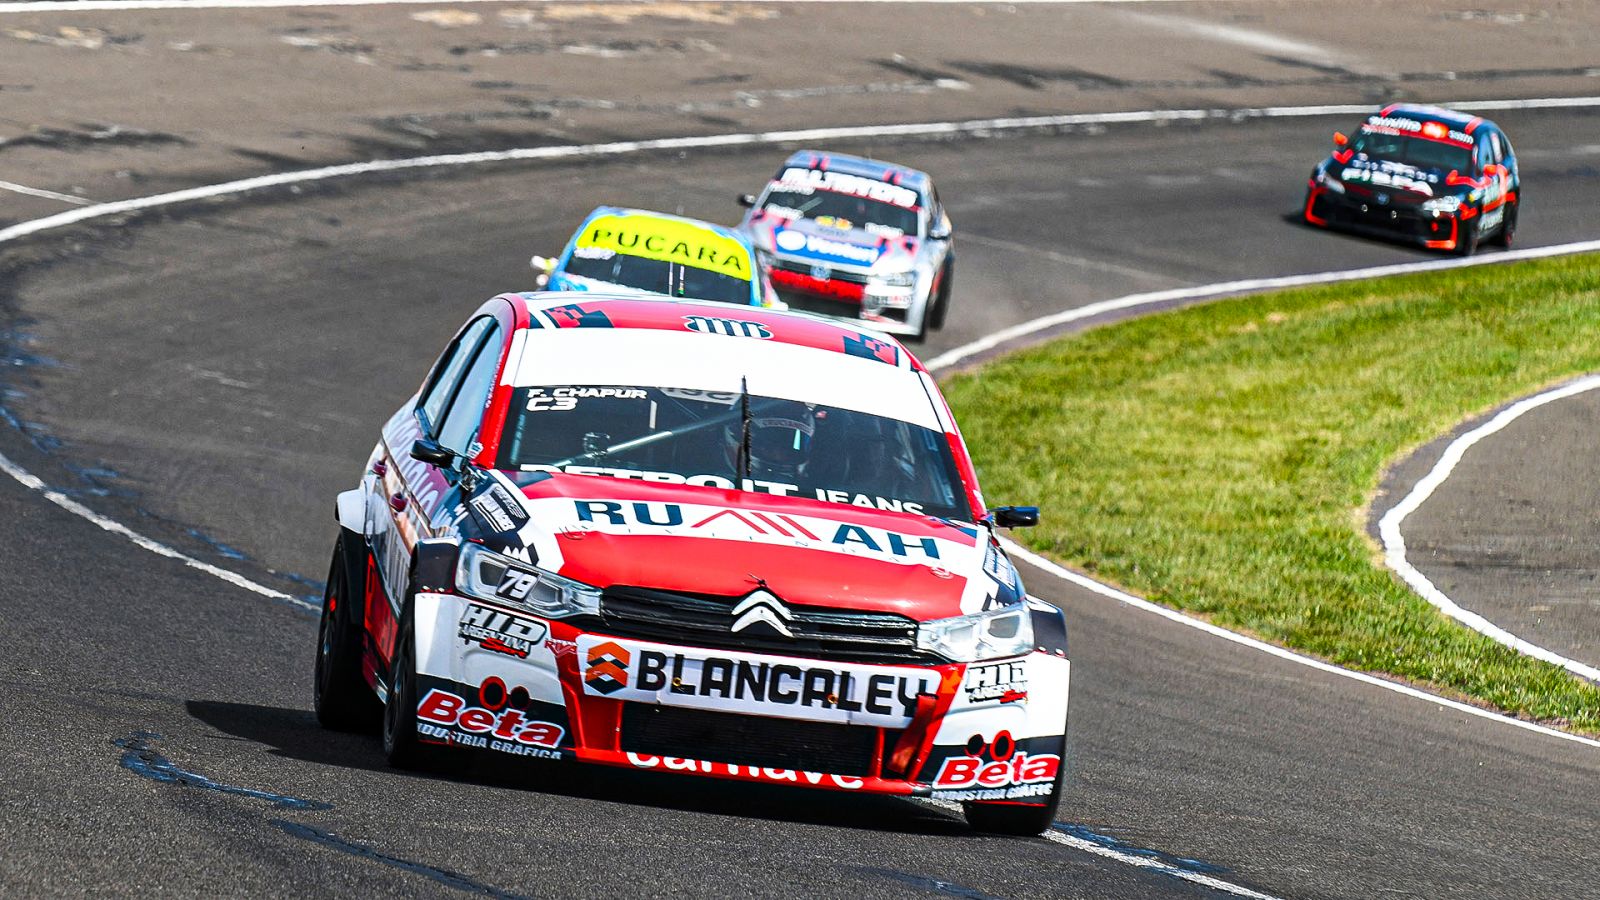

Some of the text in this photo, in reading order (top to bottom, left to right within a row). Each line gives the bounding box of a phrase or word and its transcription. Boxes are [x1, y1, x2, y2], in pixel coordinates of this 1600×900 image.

[592, 229, 742, 271] PUCARA
[526, 397, 579, 411] C3
[527, 387, 648, 399] F. CHAPUR
[497, 568, 538, 600] 79
[636, 650, 928, 717] BLANCALEY
[417, 688, 565, 748] Beta
[932, 751, 1060, 789] Beta
